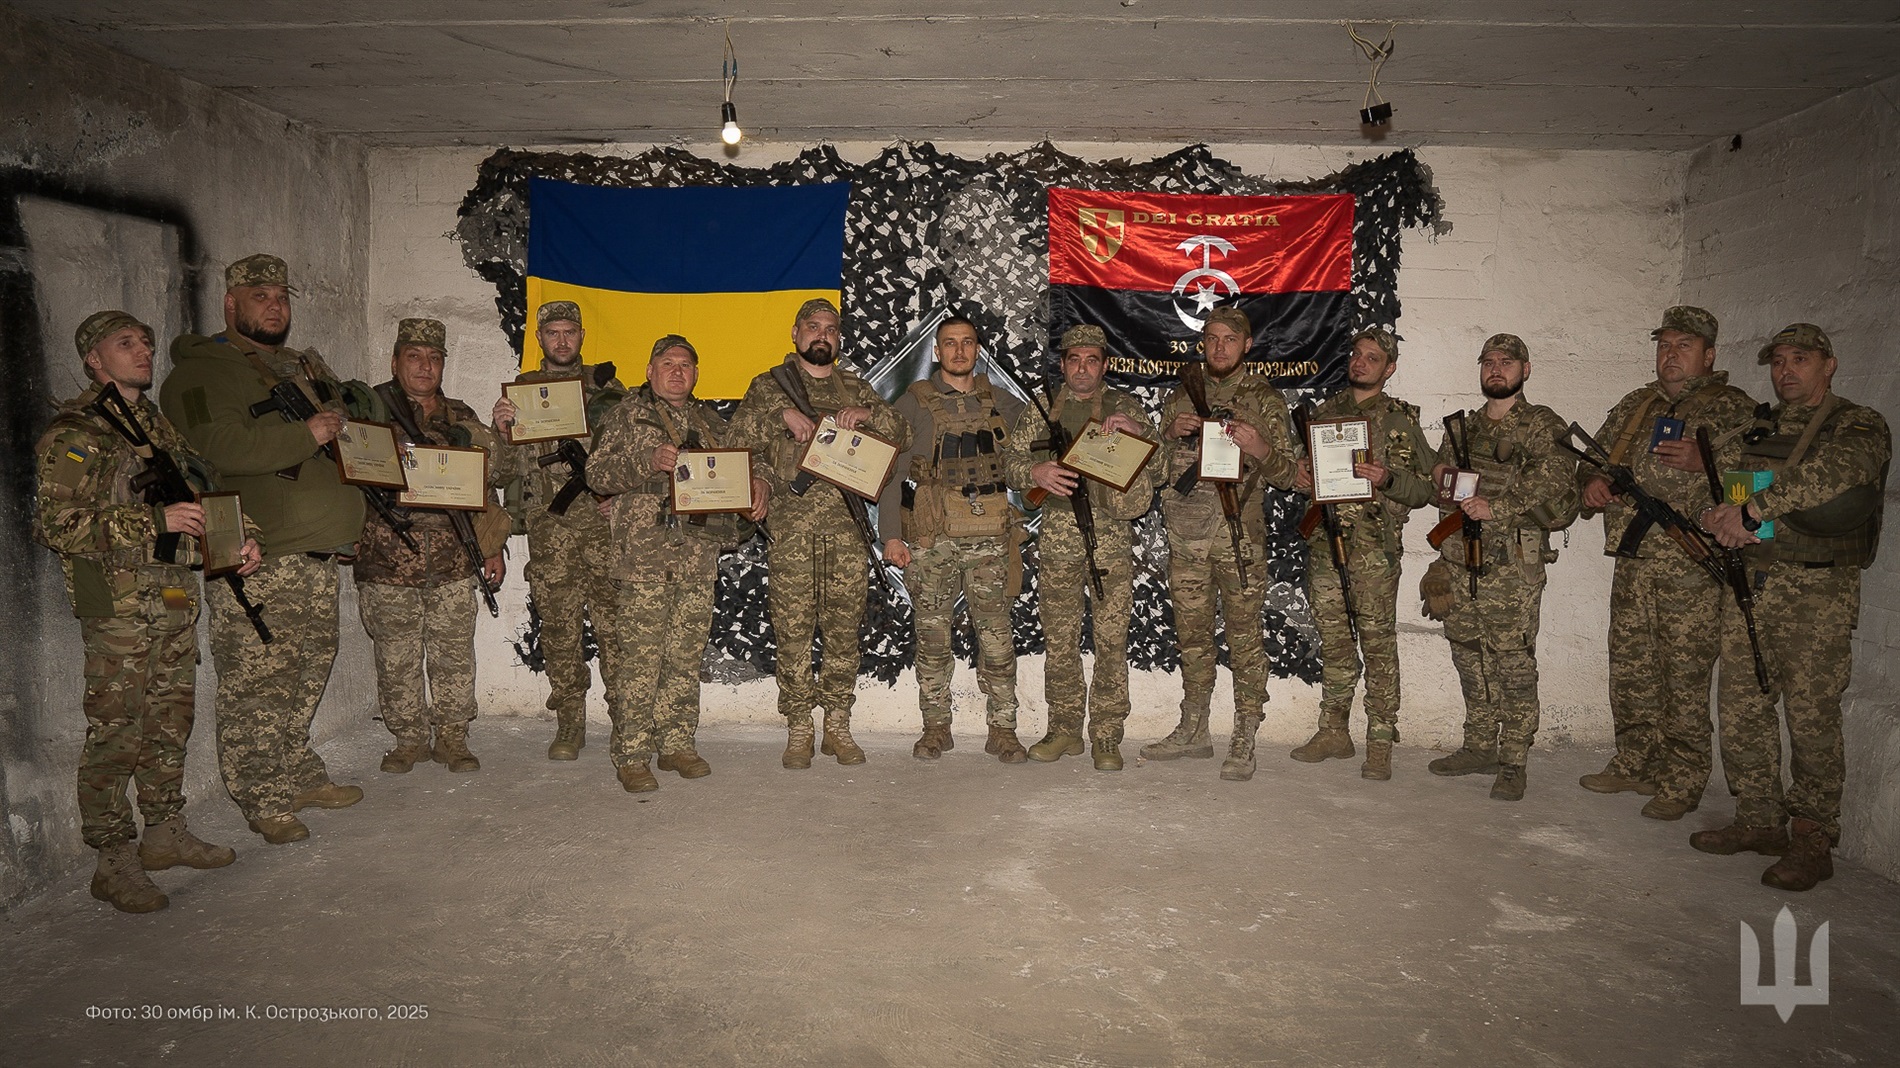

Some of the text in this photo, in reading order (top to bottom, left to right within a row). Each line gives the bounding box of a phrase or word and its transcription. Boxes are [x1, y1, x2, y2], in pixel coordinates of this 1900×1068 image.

[1132, 211, 1280, 227] DEI GRATIA
[1170, 340, 1188, 354] 30
[1108, 356, 1135, 374] ЯЗЯ
[1243, 361, 1319, 378] ТРОЗЬКОГО
